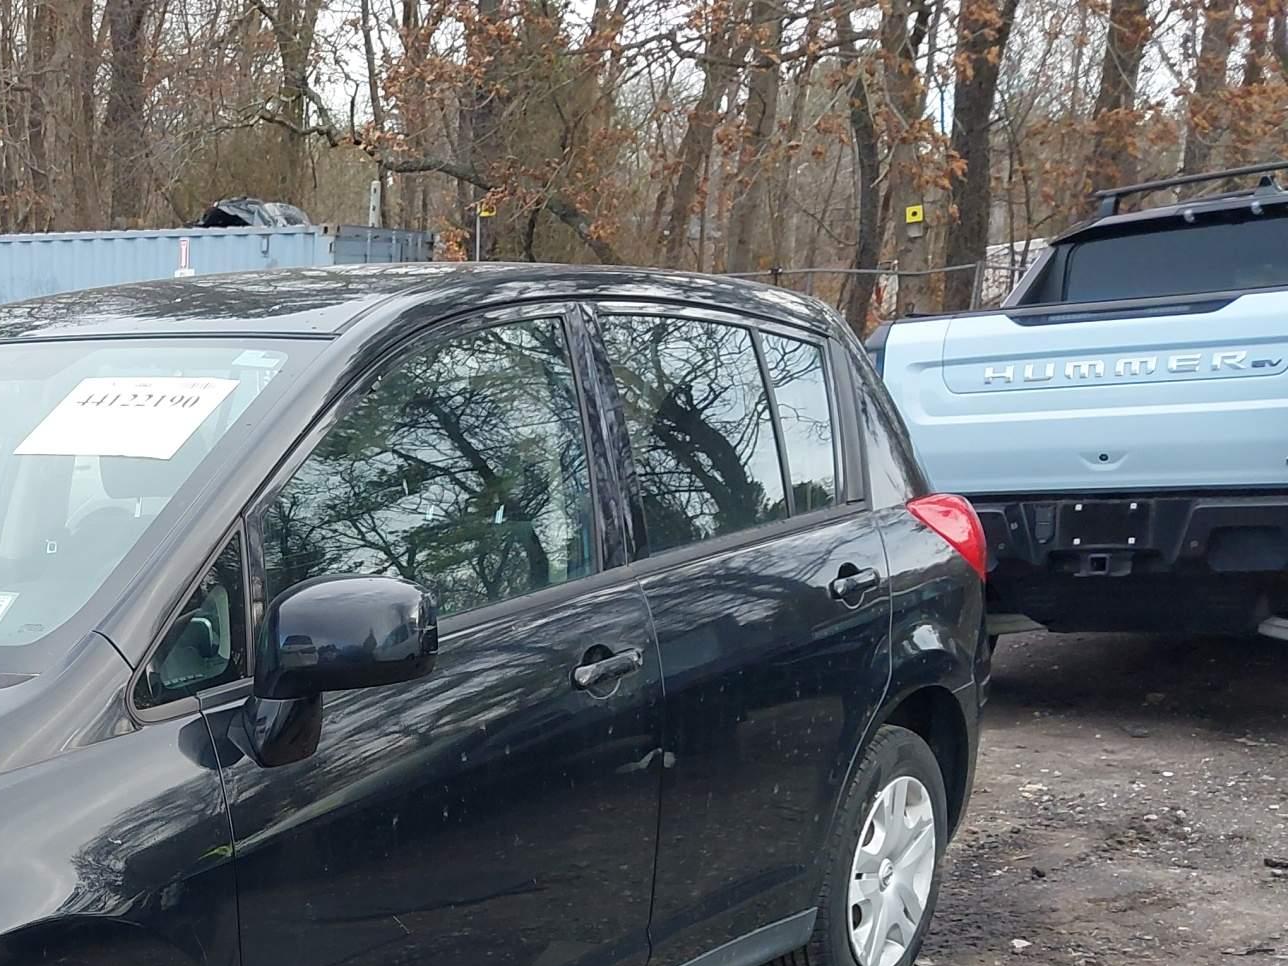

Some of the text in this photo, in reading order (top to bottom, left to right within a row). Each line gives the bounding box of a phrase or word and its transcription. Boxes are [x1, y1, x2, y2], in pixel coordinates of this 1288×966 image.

[984, 350, 1282, 385] HUMMER EV
[76, 393, 201, 408] 44122190
